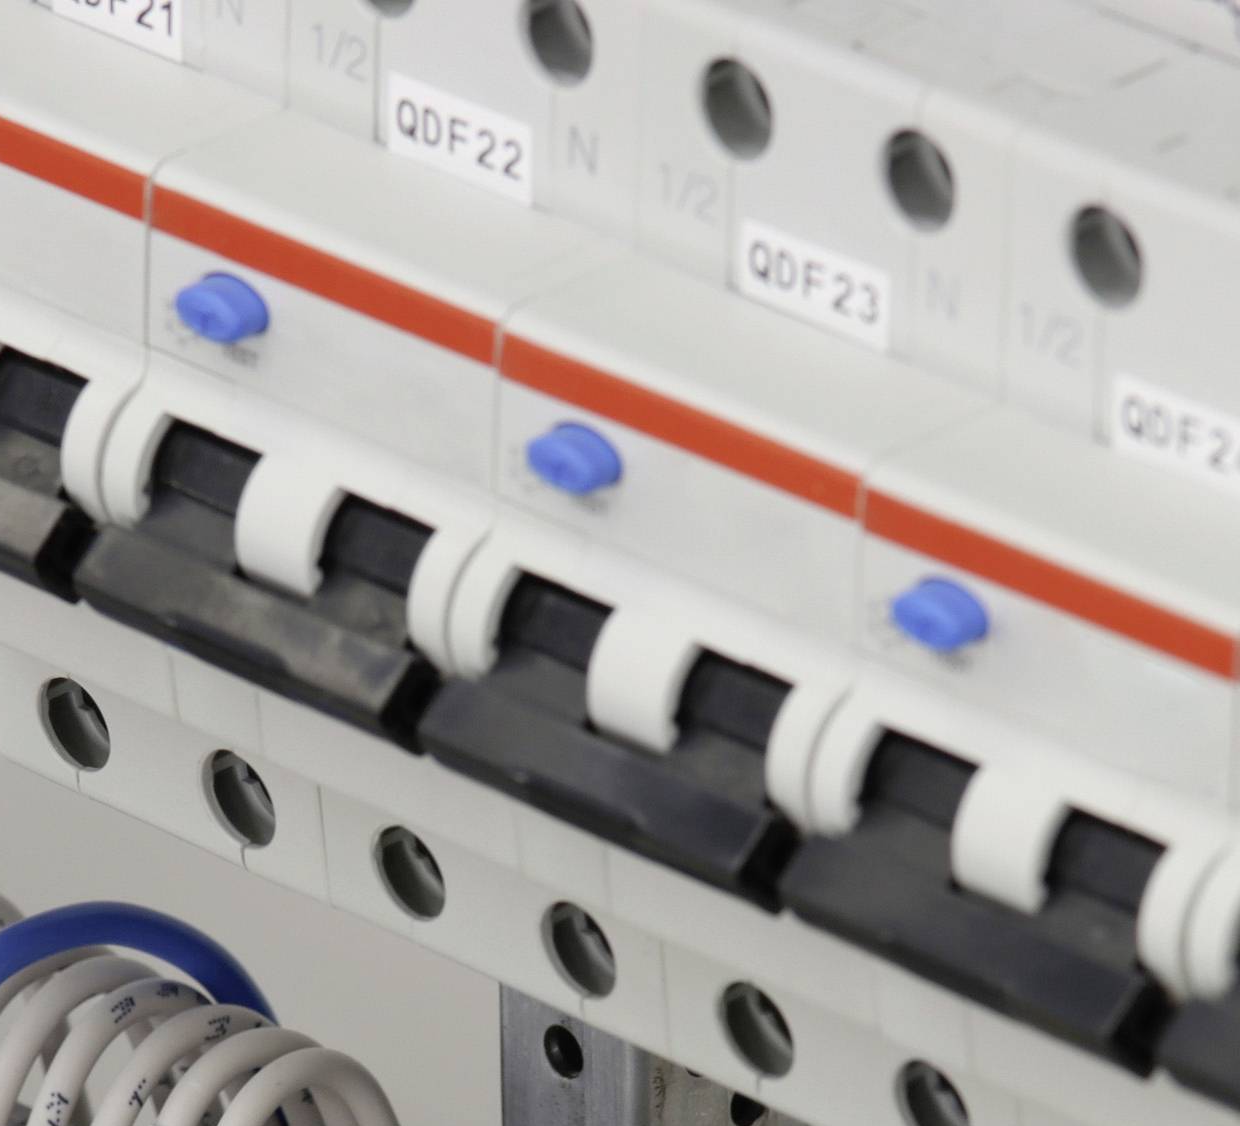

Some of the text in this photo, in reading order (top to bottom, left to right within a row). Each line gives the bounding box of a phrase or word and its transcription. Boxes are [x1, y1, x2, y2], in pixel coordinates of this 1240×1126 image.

[395, 99, 525, 182] QDF22
[567, 126, 600, 175] N
[748, 239, 881, 326] QDF23
[1120, 394, 1240, 477] QDF2
